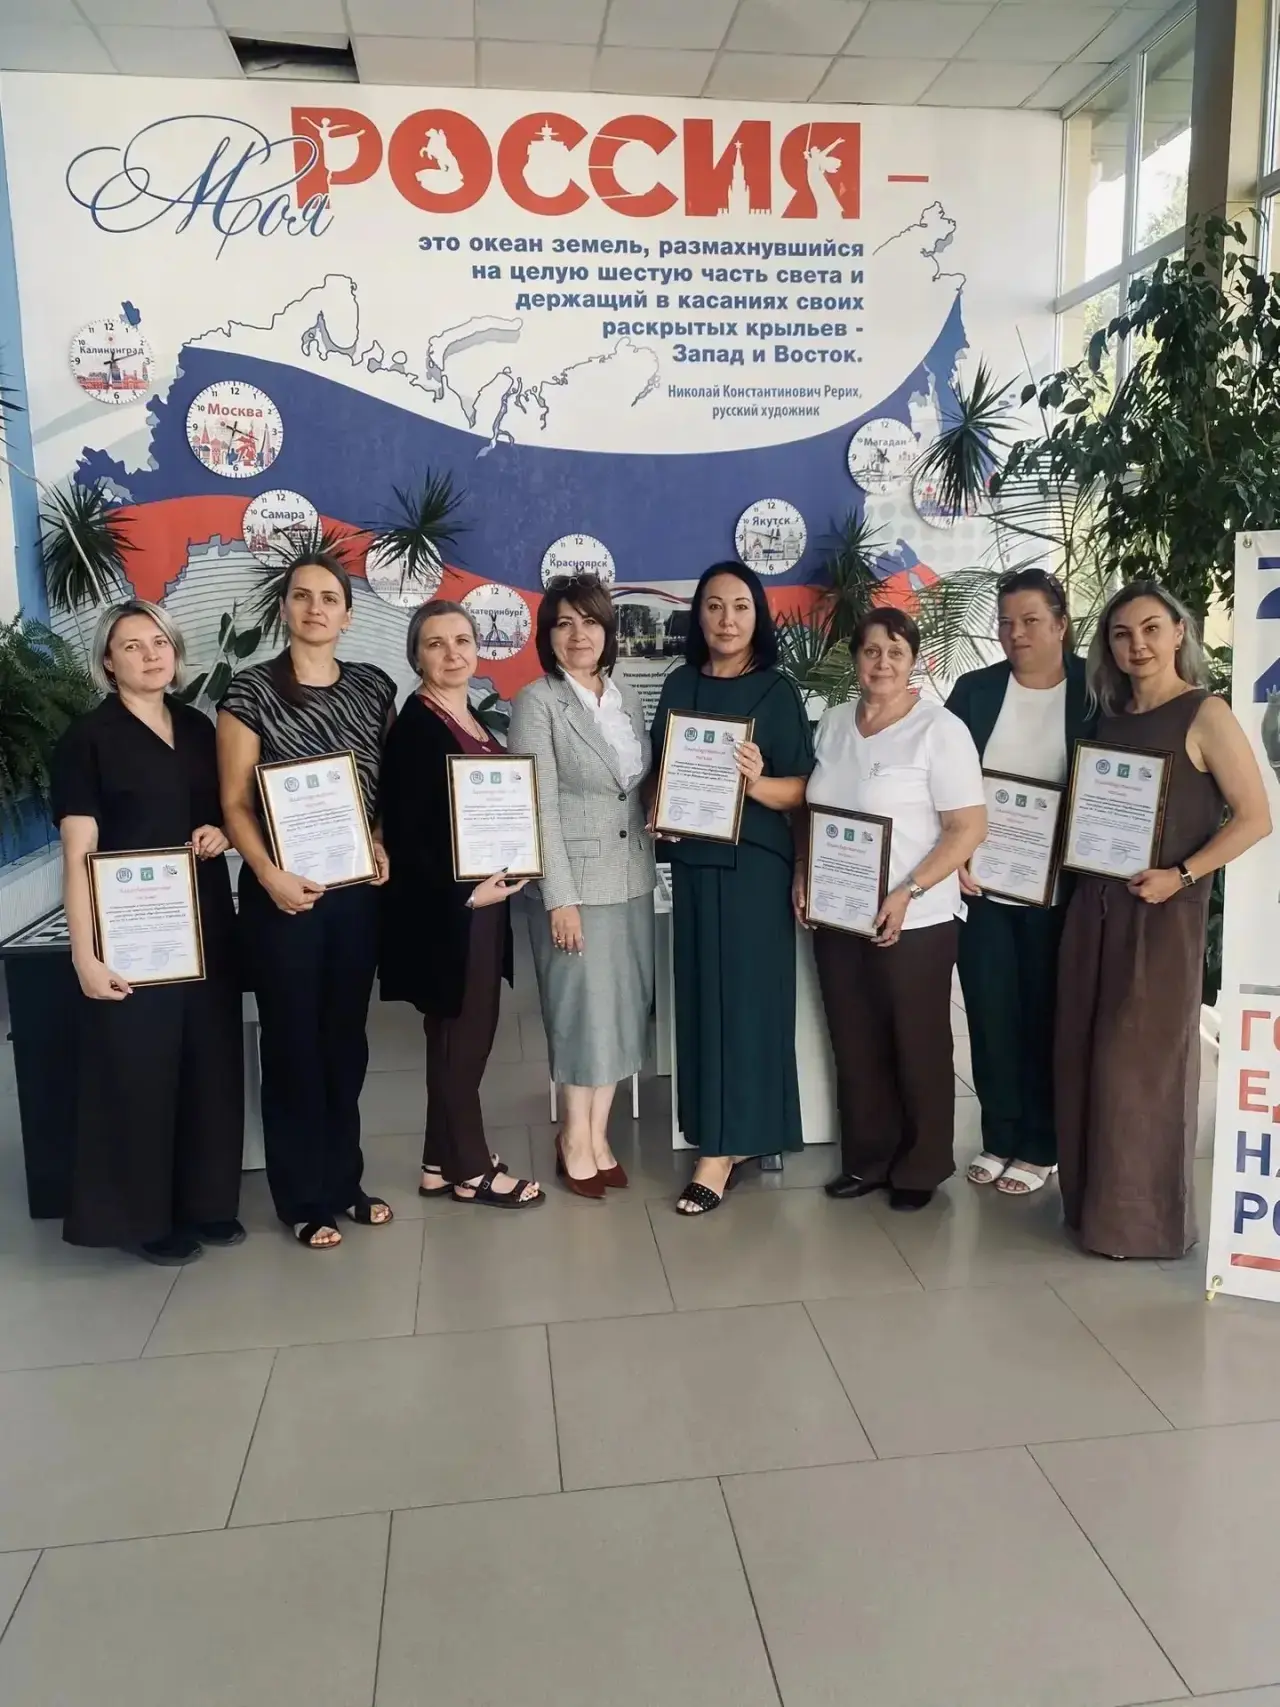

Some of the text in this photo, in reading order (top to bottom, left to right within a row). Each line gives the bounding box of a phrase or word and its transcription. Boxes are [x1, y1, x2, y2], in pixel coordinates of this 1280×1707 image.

[67, 115, 334, 260] Моя
[291, 106, 860, 220] РОССИЯ
[419, 237, 863, 259] это океан земель, размахнувшийся
[472, 266, 864, 285] на целую шестую часть света и
[516, 290, 864, 311] держащий в касаниях своих
[603, 320, 738, 339] раскрытых
[747, 323, 847, 340] крыльев
[80, 346, 144, 356] Калининград
[673, 344, 862, 365] Запад и Восток.
[668, 384, 862, 400] Николай Константинович Рерих,
[208, 403, 263, 417] Москва
[712, 404, 820, 420] русский художник
[864, 438, 906, 446] Магадан
[261, 509, 305, 521] Самара
[753, 517, 790, 527] Якутск
[550, 559, 607, 568] Красноярск
[1236, 1131, 1280, 1177] Н
